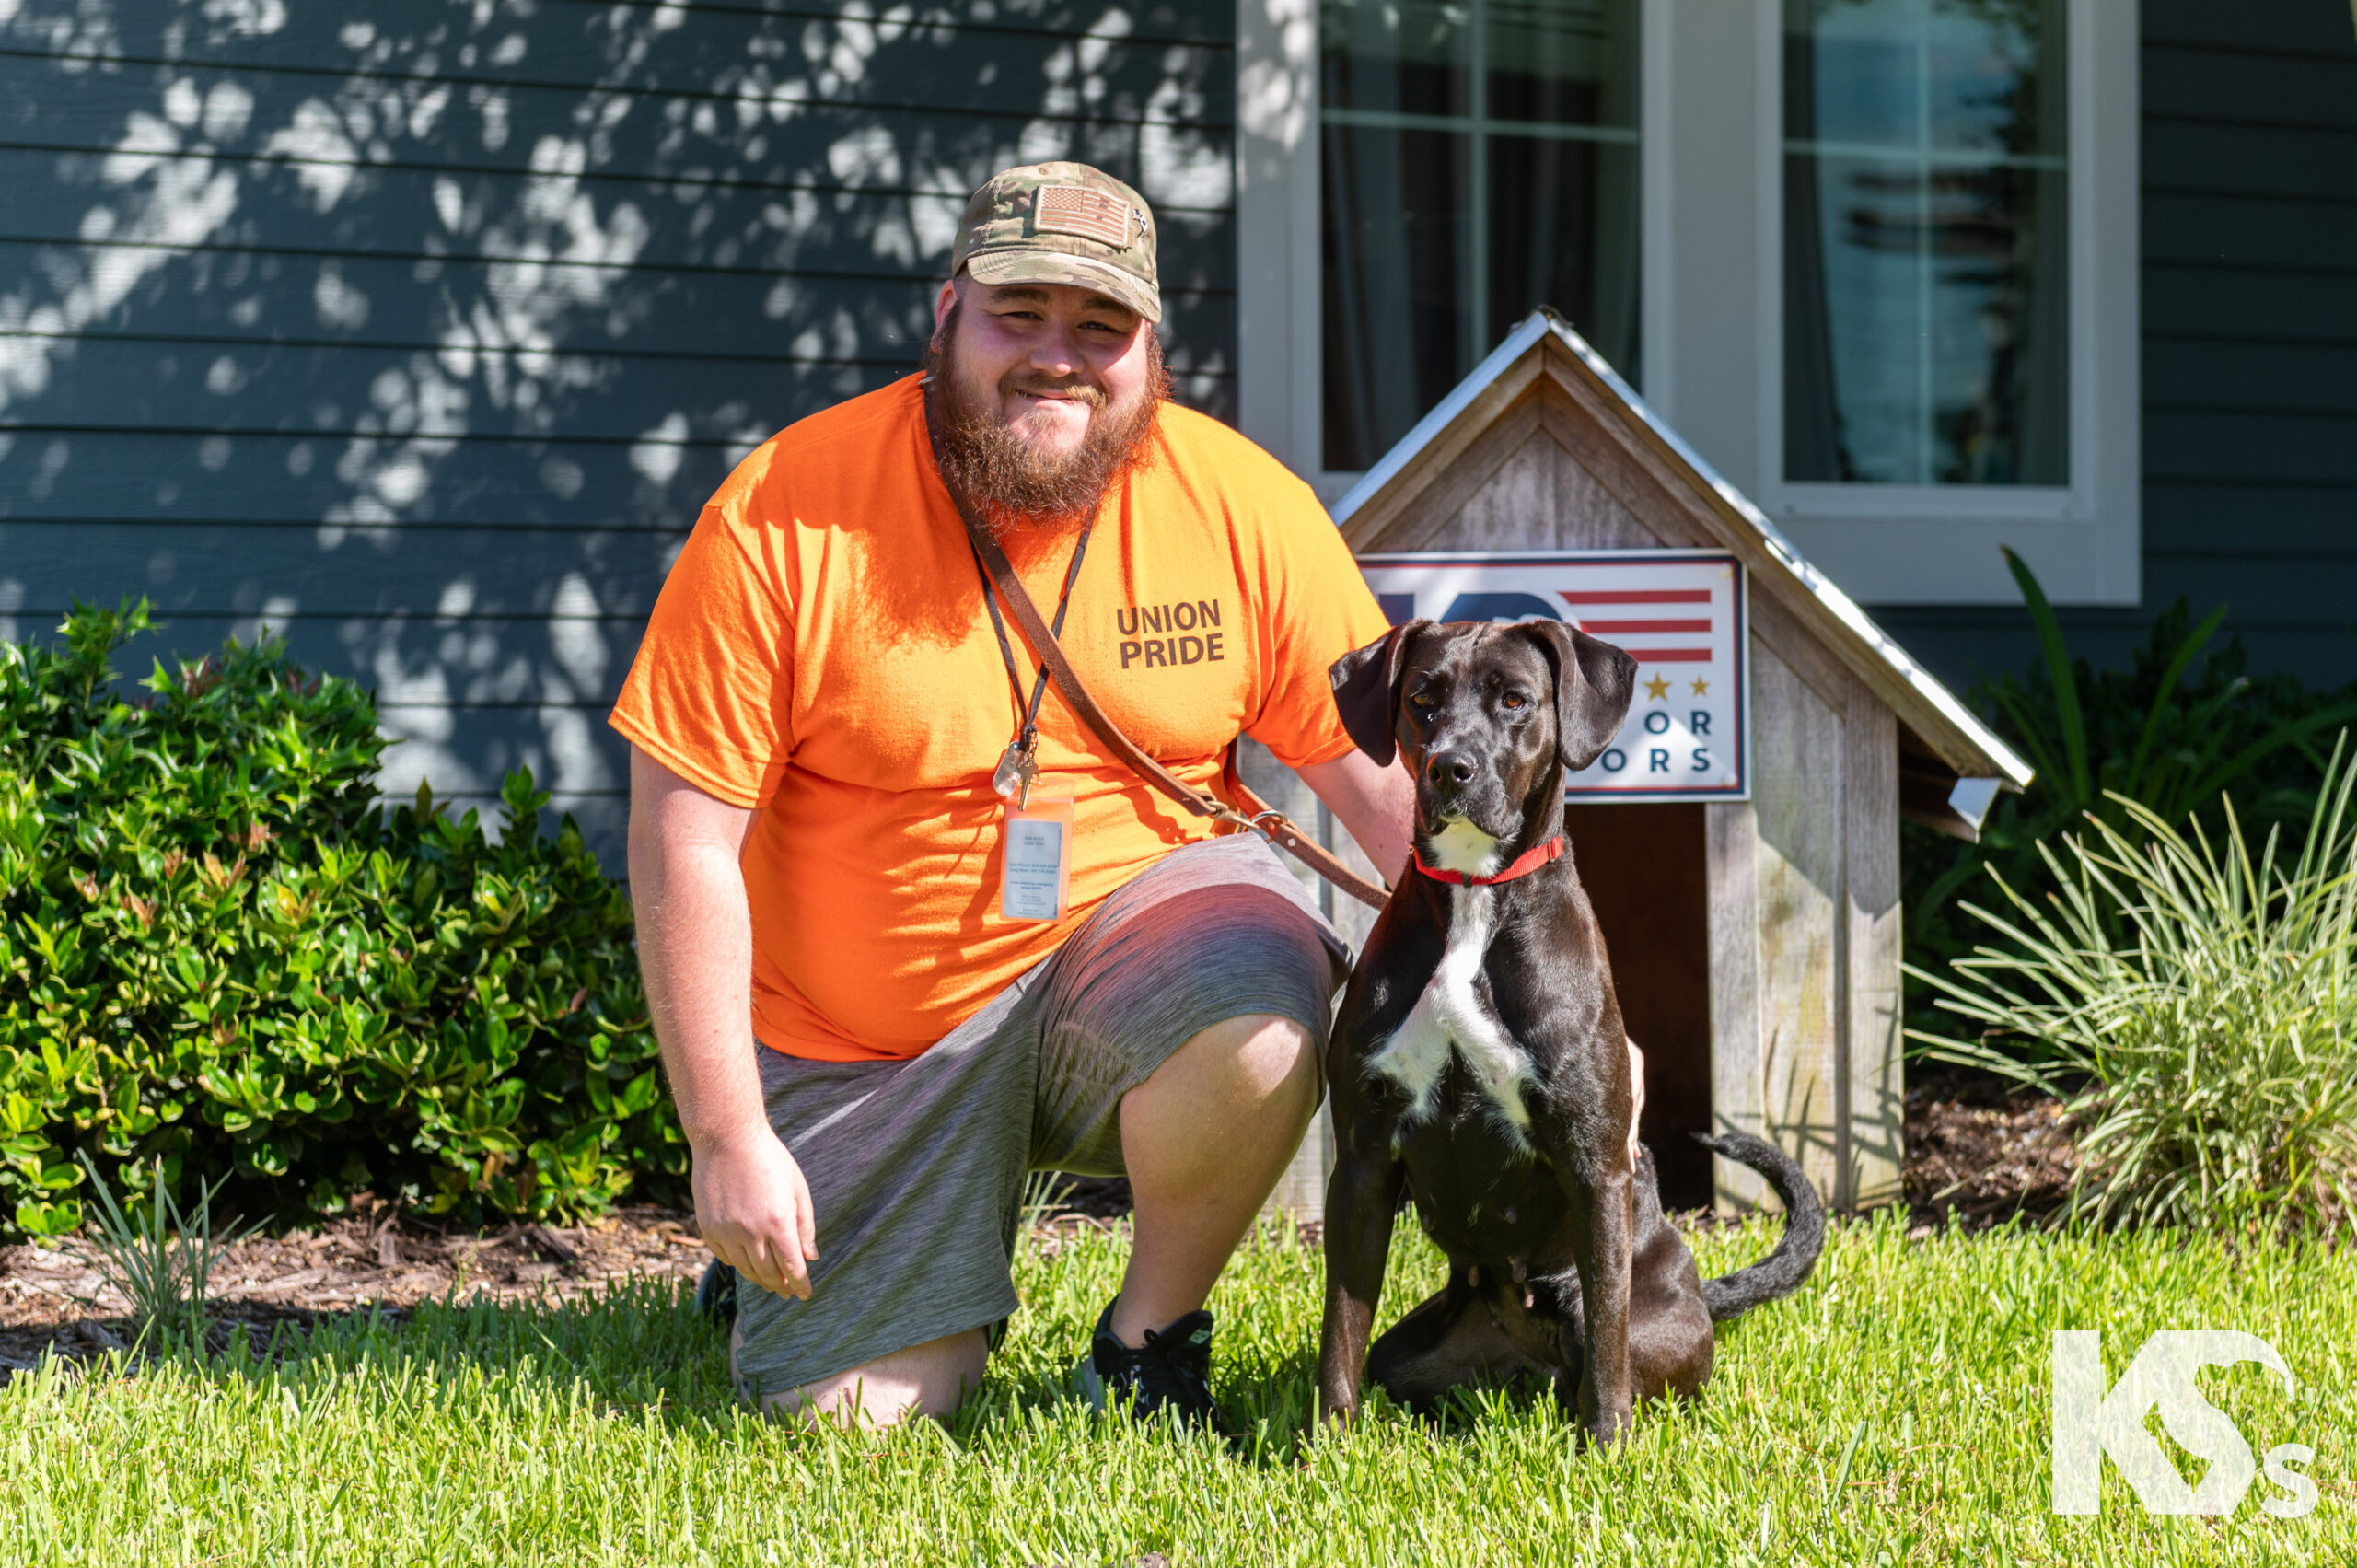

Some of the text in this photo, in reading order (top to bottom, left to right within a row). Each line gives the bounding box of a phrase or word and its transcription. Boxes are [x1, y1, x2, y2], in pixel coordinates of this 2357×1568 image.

[1117, 599, 1221, 635] UNION
[1120, 633, 1225, 669] PRIDE
[1643, 710, 1712, 735] OR
[1599, 748, 1711, 772] ORS
